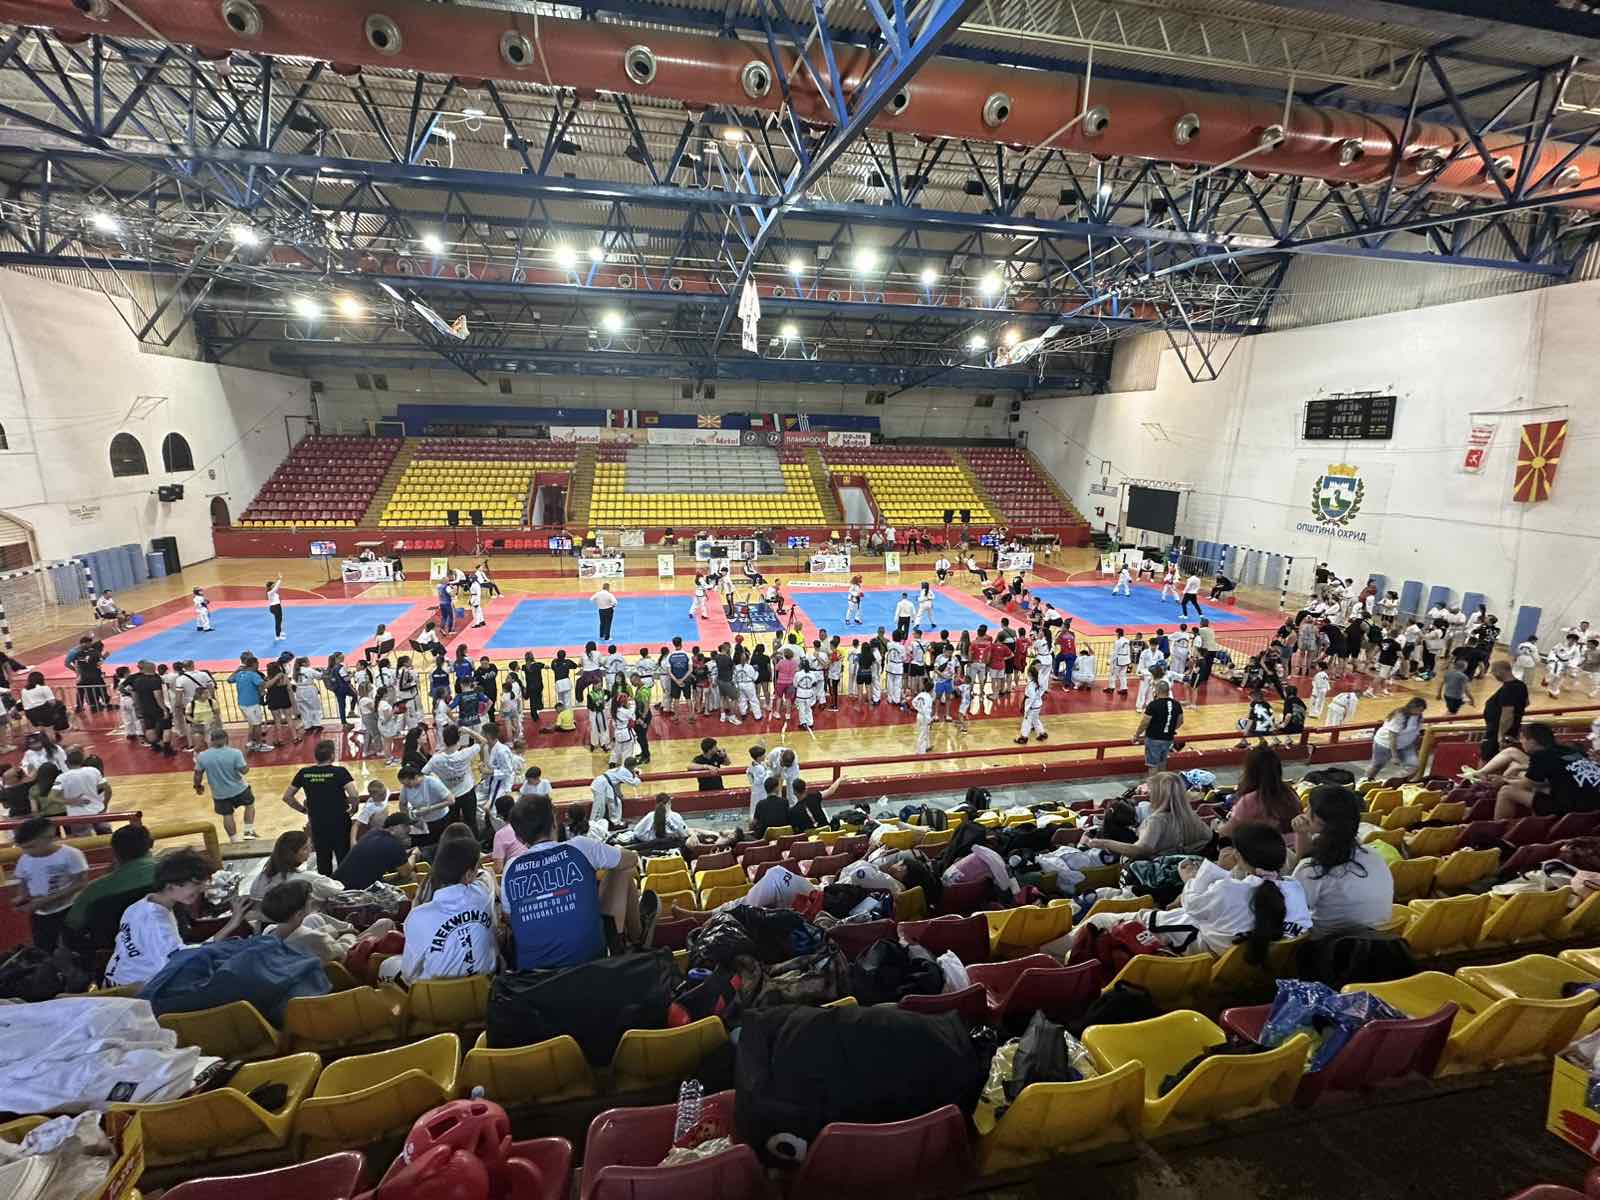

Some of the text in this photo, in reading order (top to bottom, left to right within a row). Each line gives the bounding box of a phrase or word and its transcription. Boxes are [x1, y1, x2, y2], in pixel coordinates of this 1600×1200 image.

[1296, 522, 1367, 543] ОПШТИНА ОХРИД
[615, 561, 622, 573] 2
[514, 860, 540, 872] MASTER
[509, 862, 583, 900] ITALIA
[521, 903, 576, 922] NATIONAL TEAM
